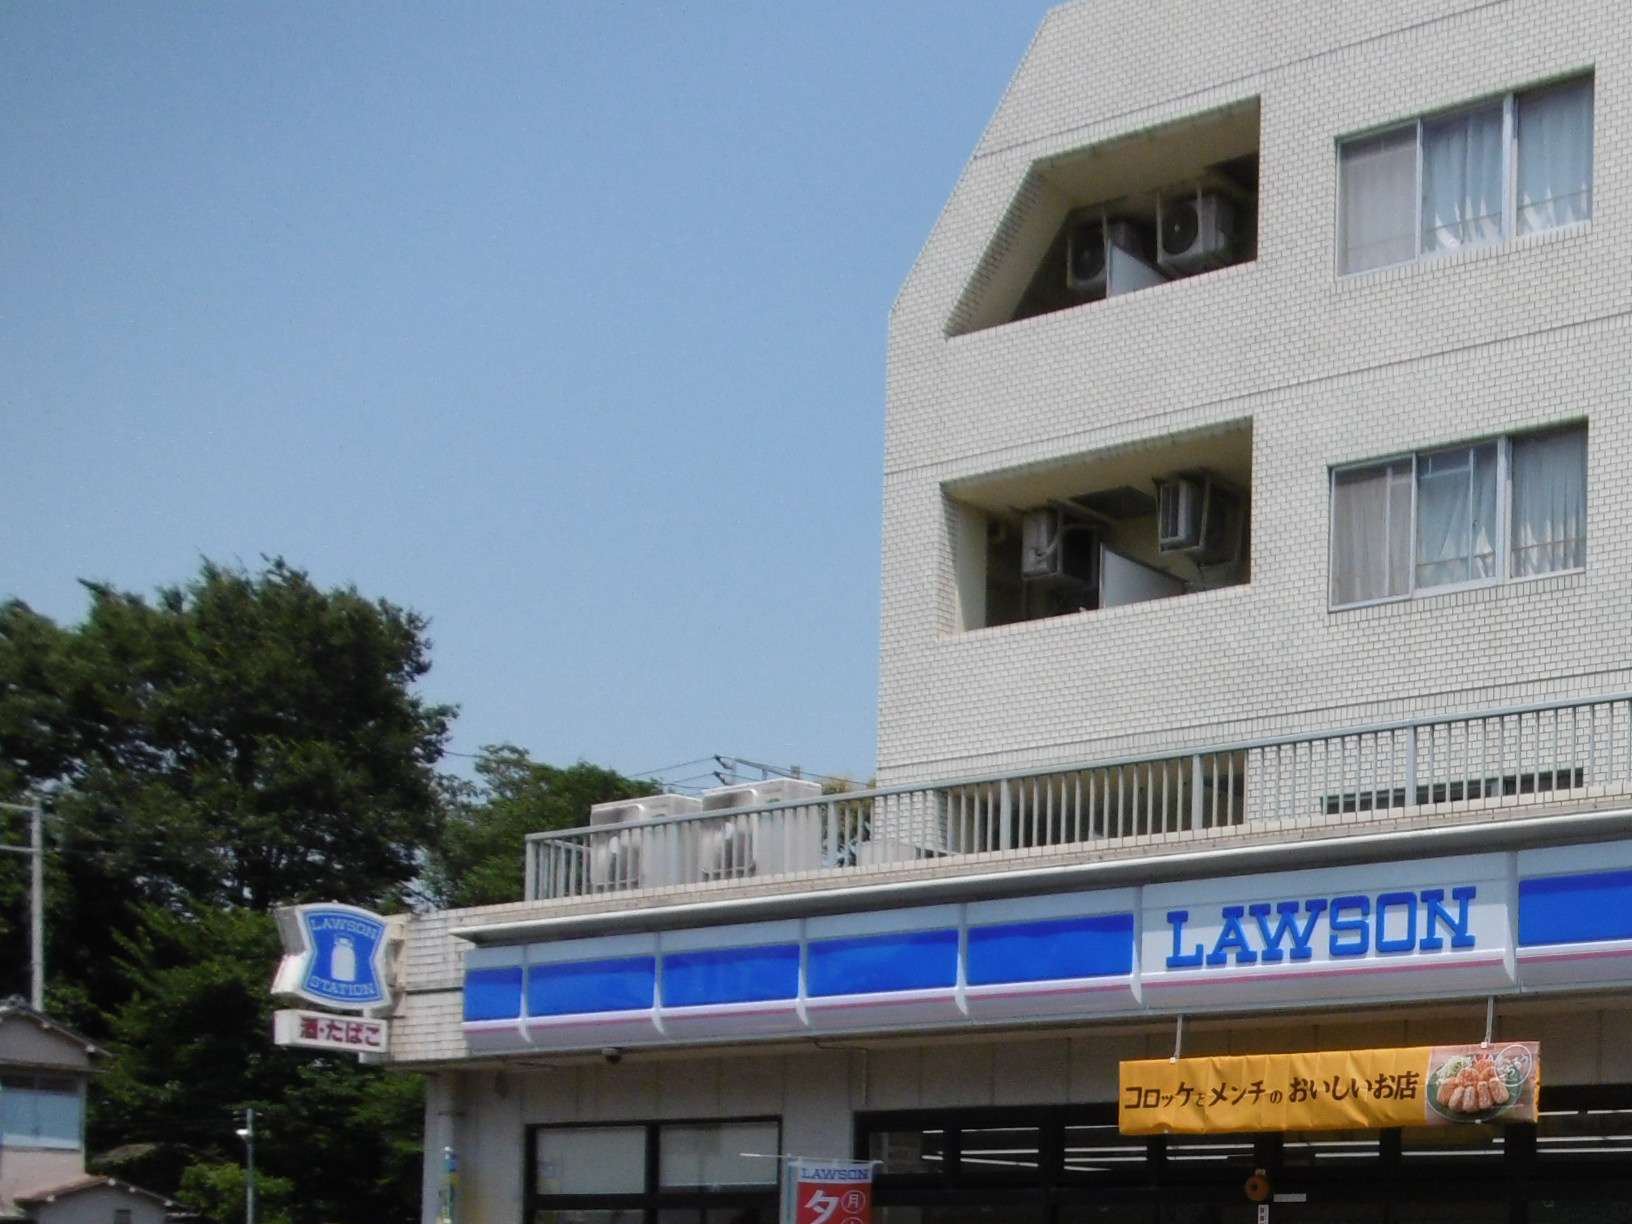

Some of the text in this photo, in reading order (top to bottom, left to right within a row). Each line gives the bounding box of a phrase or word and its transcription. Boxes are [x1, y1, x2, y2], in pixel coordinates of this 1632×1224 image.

[310, 917, 377, 939] LAWSON
[1166, 886, 1477, 968] LAWSON
[309, 976, 375, 996] STATION
[800, 1168, 870, 1181] LAWSON
